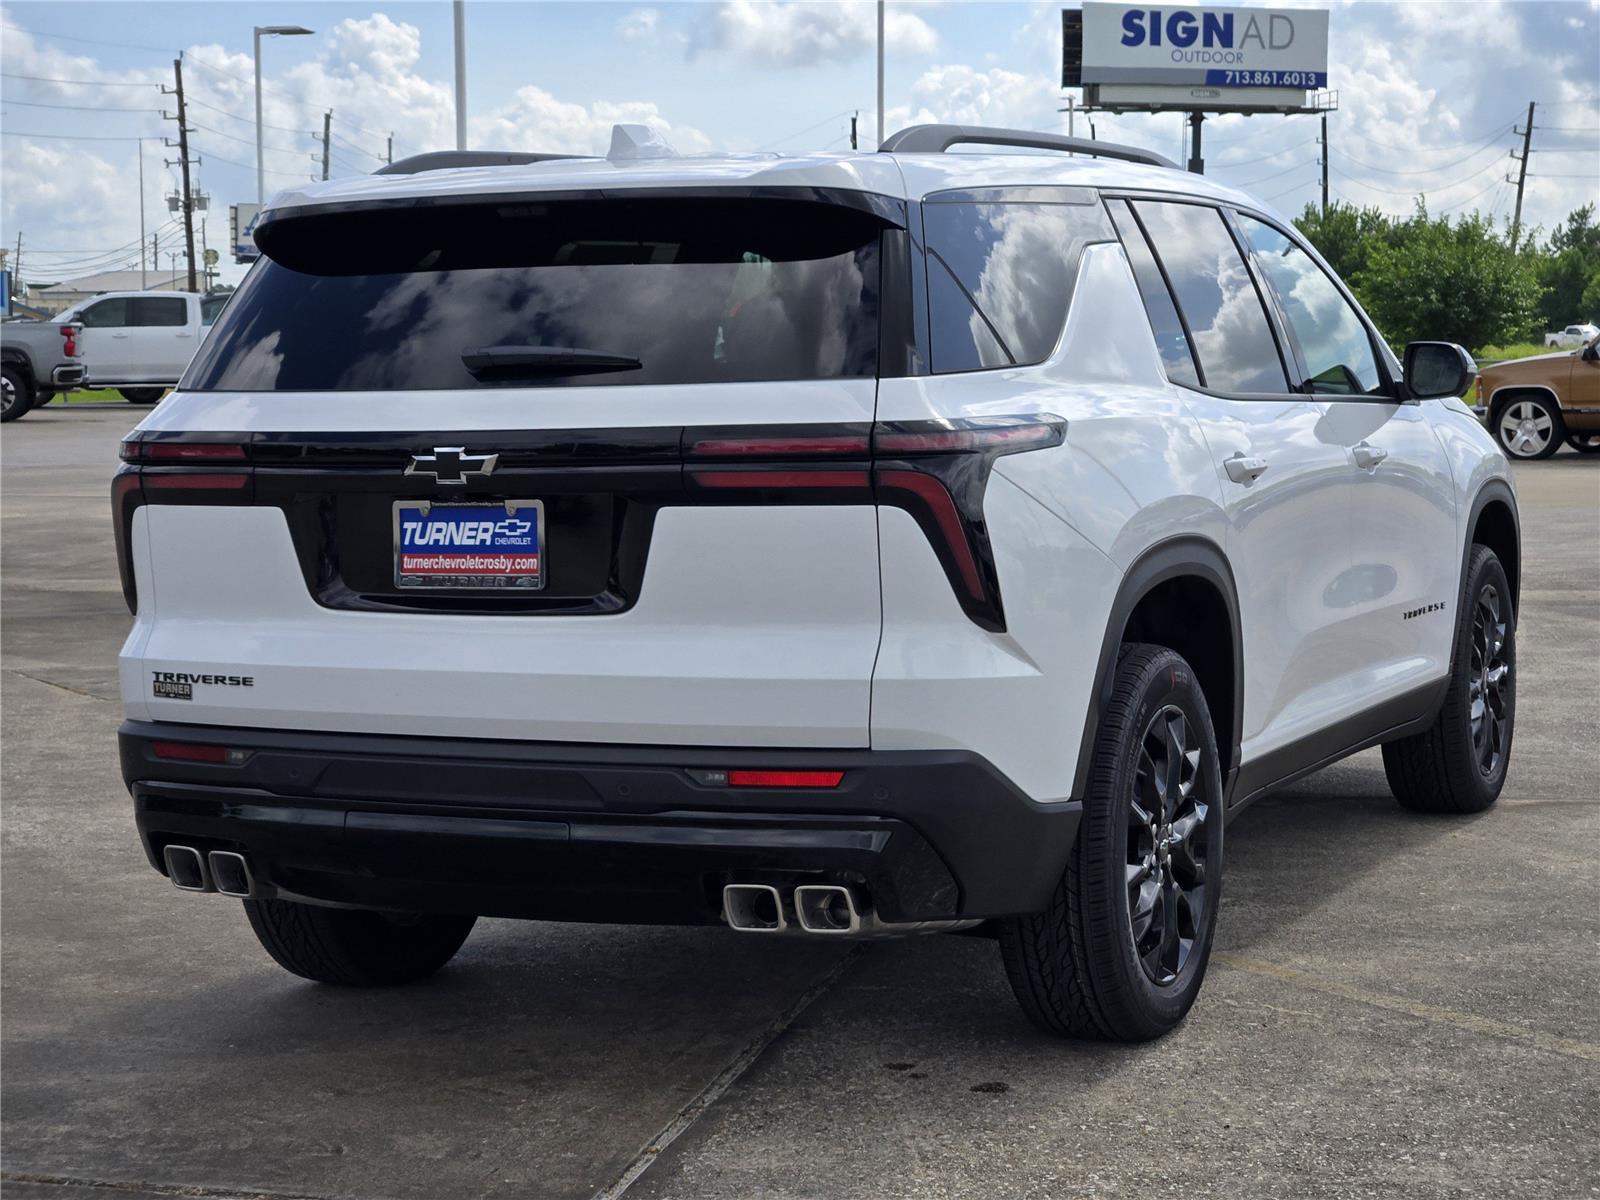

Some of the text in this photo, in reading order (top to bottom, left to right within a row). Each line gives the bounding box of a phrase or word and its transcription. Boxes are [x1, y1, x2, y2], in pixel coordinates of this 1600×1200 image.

[1171, 49, 1244, 64] OUTDOOR
[1225, 71, 1316, 85] 713.861.6013
[402, 521, 495, 545] TURNER
[494, 537, 532, 545] CHEVROLET
[403, 555, 538, 572] turnerchevroletcrosby.com
[430, 576, 506, 587] TURNER
[1403, 601, 1447, 620] TRAVERSE
[152, 671, 254, 686] TRAVERSE
[154, 682, 190, 695] TURNER
